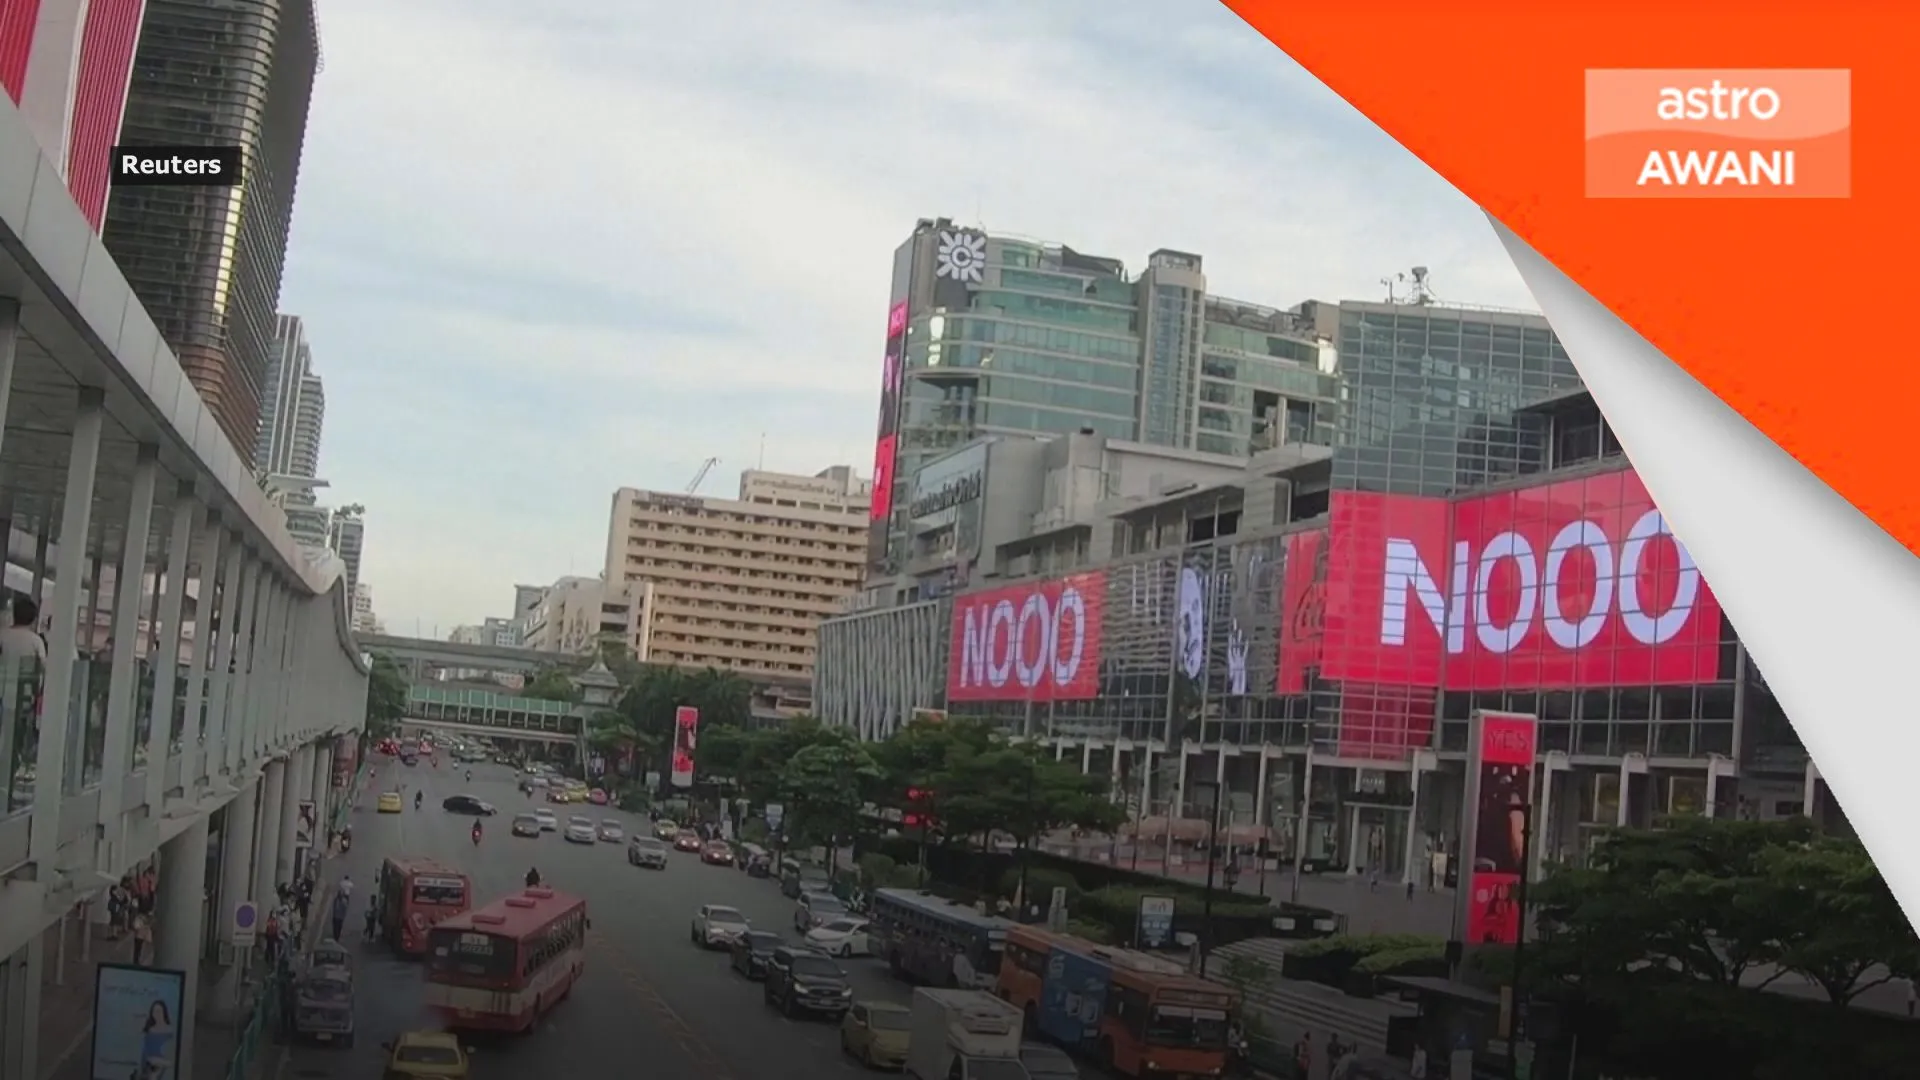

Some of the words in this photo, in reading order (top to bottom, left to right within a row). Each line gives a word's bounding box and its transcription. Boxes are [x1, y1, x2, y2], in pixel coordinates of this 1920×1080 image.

[1381, 508, 1699, 653] NOOO
[960, 587, 1084, 689] NOOO
[1487, 729, 1529, 751] YES
